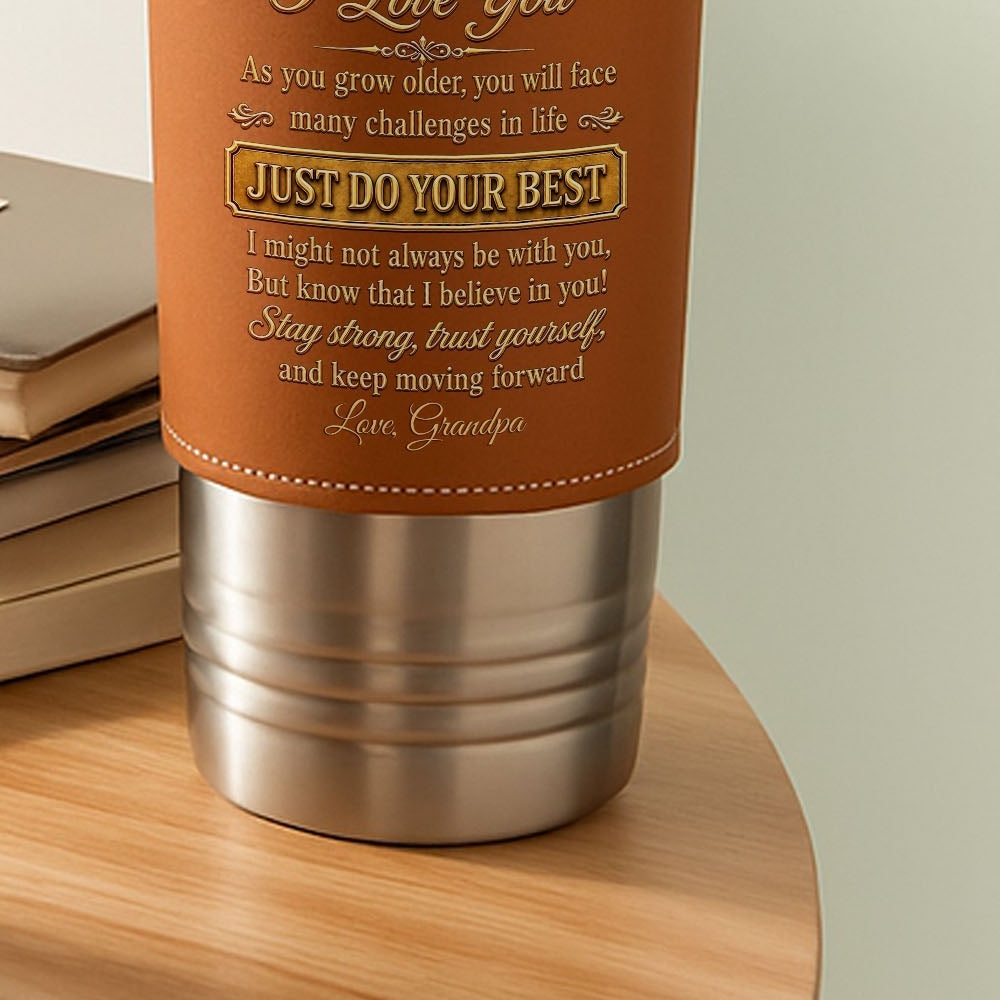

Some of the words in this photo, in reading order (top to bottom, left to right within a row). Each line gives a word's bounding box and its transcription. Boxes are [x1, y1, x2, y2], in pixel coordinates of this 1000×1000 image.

[240, 55, 273, 85] As
[280, 68, 325, 93] you
[334, 72, 395, 97] grow
[403, 66, 467, 97] older,
[472, 72, 515, 100] you
[521, 63, 563, 92] will
[570, 61, 617, 87] face
[289, 109, 356, 140] many
[365, 109, 491, 144] challenges
[500, 110, 523, 135] in
[530, 106, 568, 133] life
[247, 162, 339, 208] JUST
[348, 172, 398, 212] DO
[408, 173, 507, 212] YOUR
[516, 164, 607, 211] BEST
[247, 229, 256, 255] I
[264, 235, 333, 266] might
[340, 244, 380, 266] not
[388, 242, 464, 274] always
[473, 242, 499, 267] be
[507, 238, 556, 265] with
[564, 239, 611, 263] you,
[247, 268, 289, 297] But
[296, 274, 360, 305] know
[368, 279, 415, 306] that
[422, 281, 431, 306] I
[440, 278, 521, 306] believe
[528, 276, 551, 302] in
[558, 269, 608, 299] you!
[248, 306, 322, 354] Stay
[326, 319, 418, 361] strong,
[426, 321, 491, 350] trust
[489, 308, 607, 360] yourself,
[278, 358, 323, 385] and
[331, 361, 387, 395] keep
[395, 367, 484, 398] moving
[491, 356, 585, 389] forward
[324, 399, 397, 445] Love,
[406, 402, 526, 451] Grandpa
